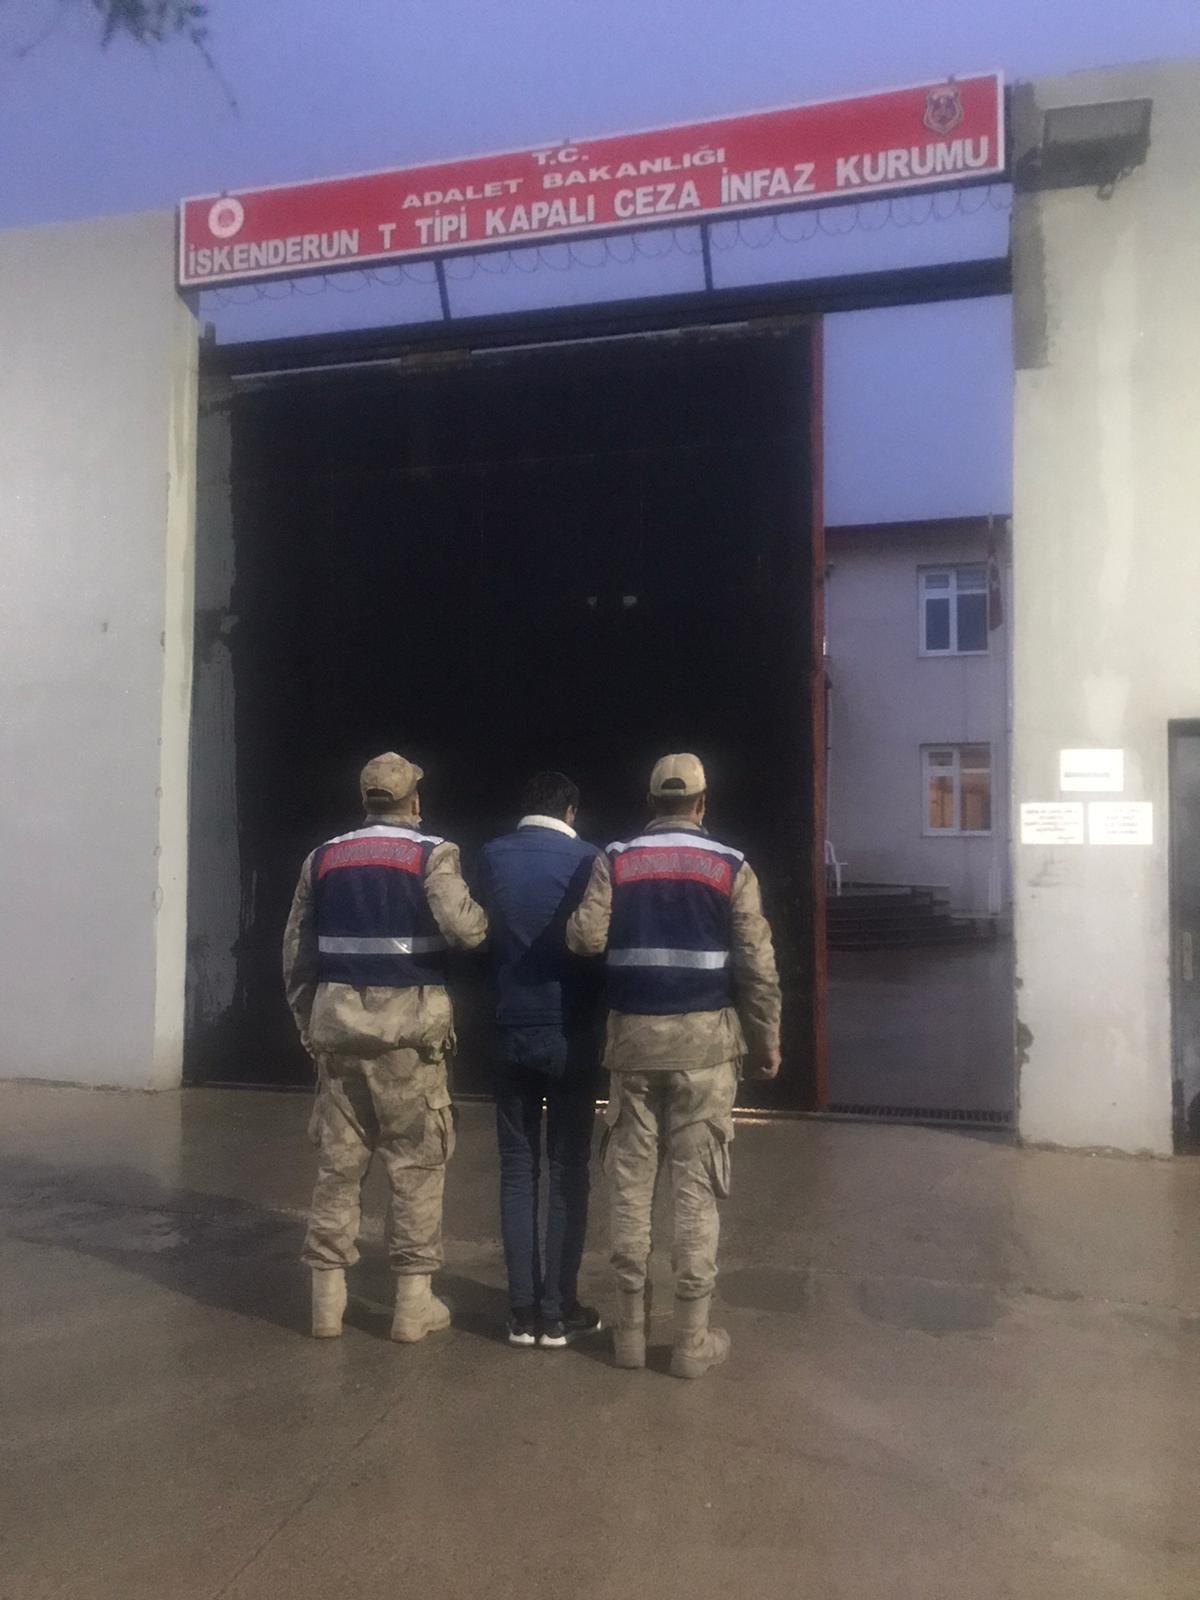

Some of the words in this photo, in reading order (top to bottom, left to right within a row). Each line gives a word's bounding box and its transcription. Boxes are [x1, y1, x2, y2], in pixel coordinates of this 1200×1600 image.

[402, 178, 524, 210] ADALET
[543, 145, 726, 190] BAKANLIĞI
[532, 148, 589, 166] T.C.
[188, 229, 360, 276] İSKENDERUN
[378, 223, 397, 250] T
[415, 206, 467, 246] TİPİ
[485, 194, 595, 236] KAPALI
[614, 179, 701, 218] CEZA
[720, 163, 815, 205] İNFAZ
[835, 136, 989, 187] KURUMU
[620, 853, 726, 882] JANDARMA
